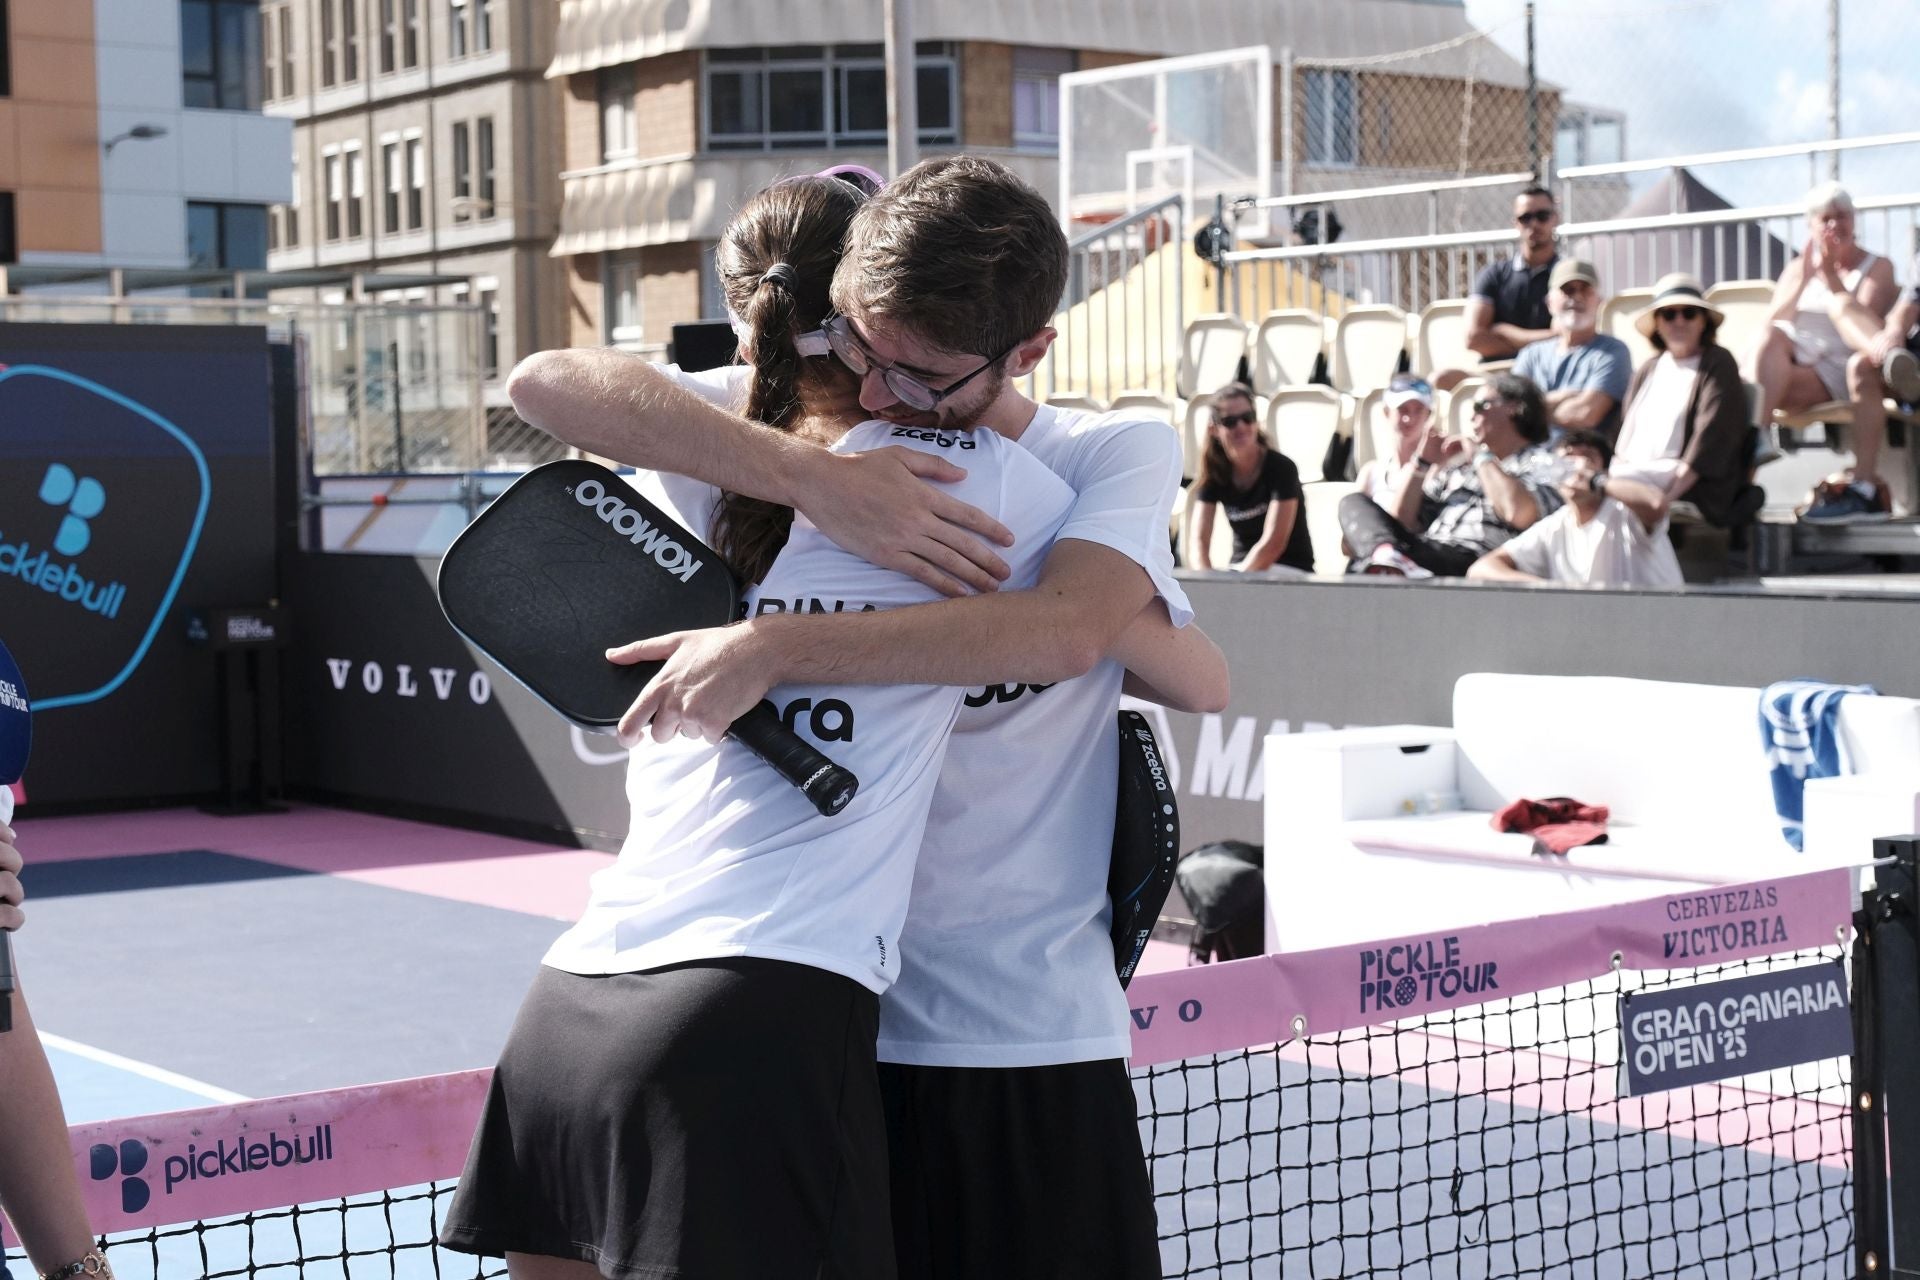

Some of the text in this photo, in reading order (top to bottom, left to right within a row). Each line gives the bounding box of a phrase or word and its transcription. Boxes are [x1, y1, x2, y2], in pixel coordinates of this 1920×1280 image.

[891, 427, 976, 450] zcebra
[575, 479, 704, 583] KOMODO
[0, 541, 127, 619] cklebull
[326, 658, 491, 705] VOLVO
[764, 698, 854, 742] ra
[1141, 744, 1167, 791] zcebra
[1667, 886, 1778, 922] CERVEZAS
[1360, 936, 1460, 982] PICKLE
[1663, 915, 1788, 958] VICTORIA
[1631, 980, 1844, 1043] GRAN CANARIA
[1635, 1032, 1715, 1076] OPEN
[165, 1124, 332, 1194] picklebull
